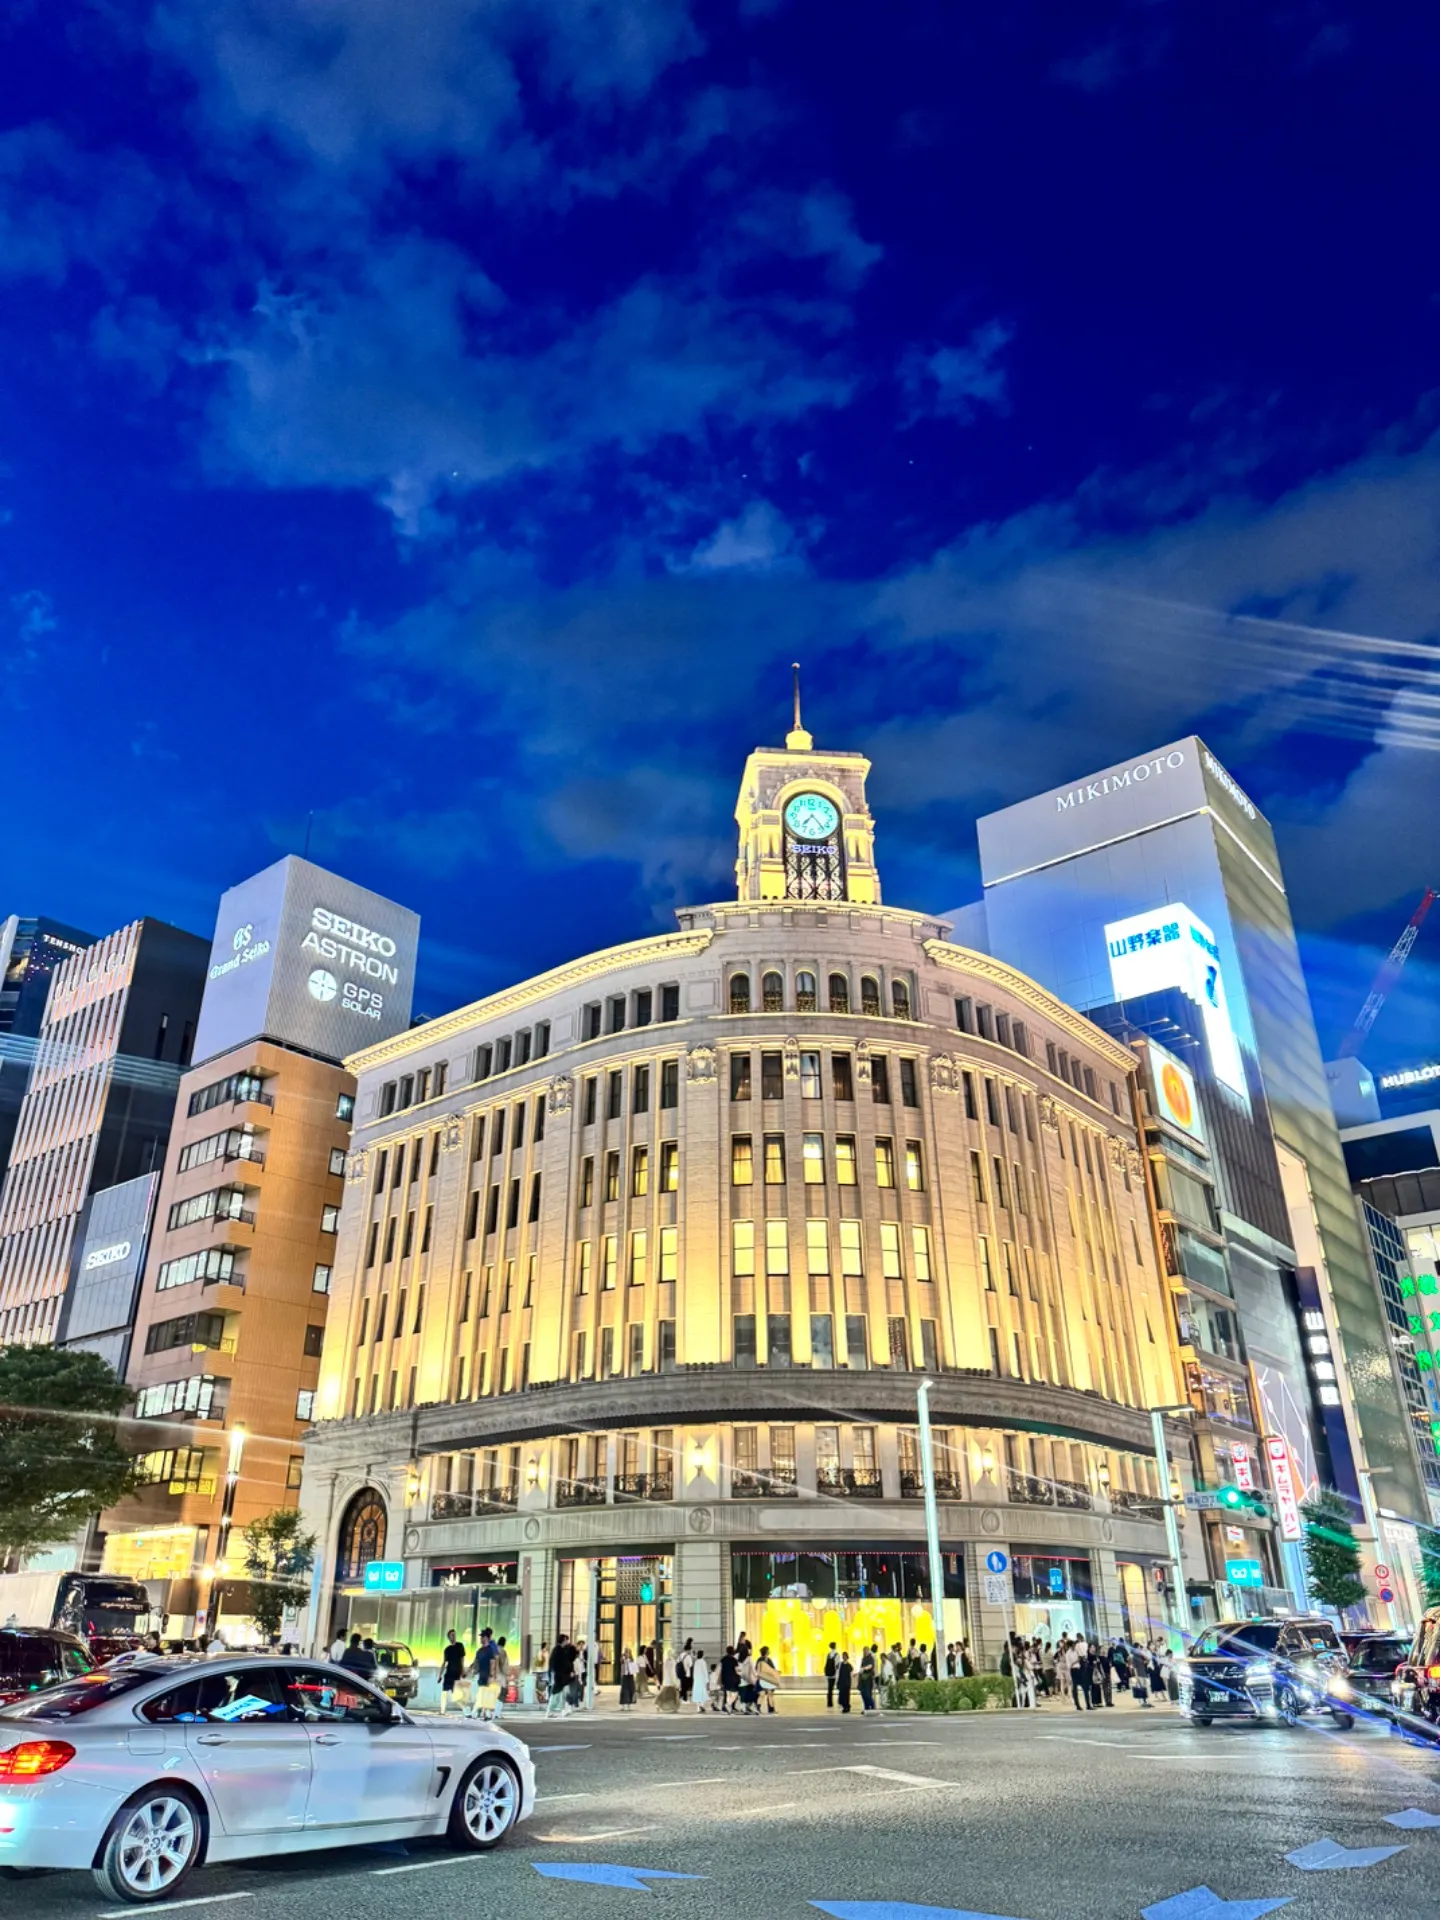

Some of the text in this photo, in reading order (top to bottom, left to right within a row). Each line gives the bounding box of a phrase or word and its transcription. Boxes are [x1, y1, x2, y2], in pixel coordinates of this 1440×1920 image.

[1056, 751, 1185, 812] MIKIMOTO
[792, 844, 837, 854] SEIKO
[43, 934, 87, 955] TENSHO
[311, 907, 397, 957] SEIKO
[1109, 922, 1180, 958] 山野楽器
[210, 940, 271, 980] Grand Seiko
[301, 931, 399, 986] ASTRON
[341, 997, 381, 1021] SOLAR
[343, 982, 383, 1009] GPS
[86, 1241, 130, 1270] SEIKO
